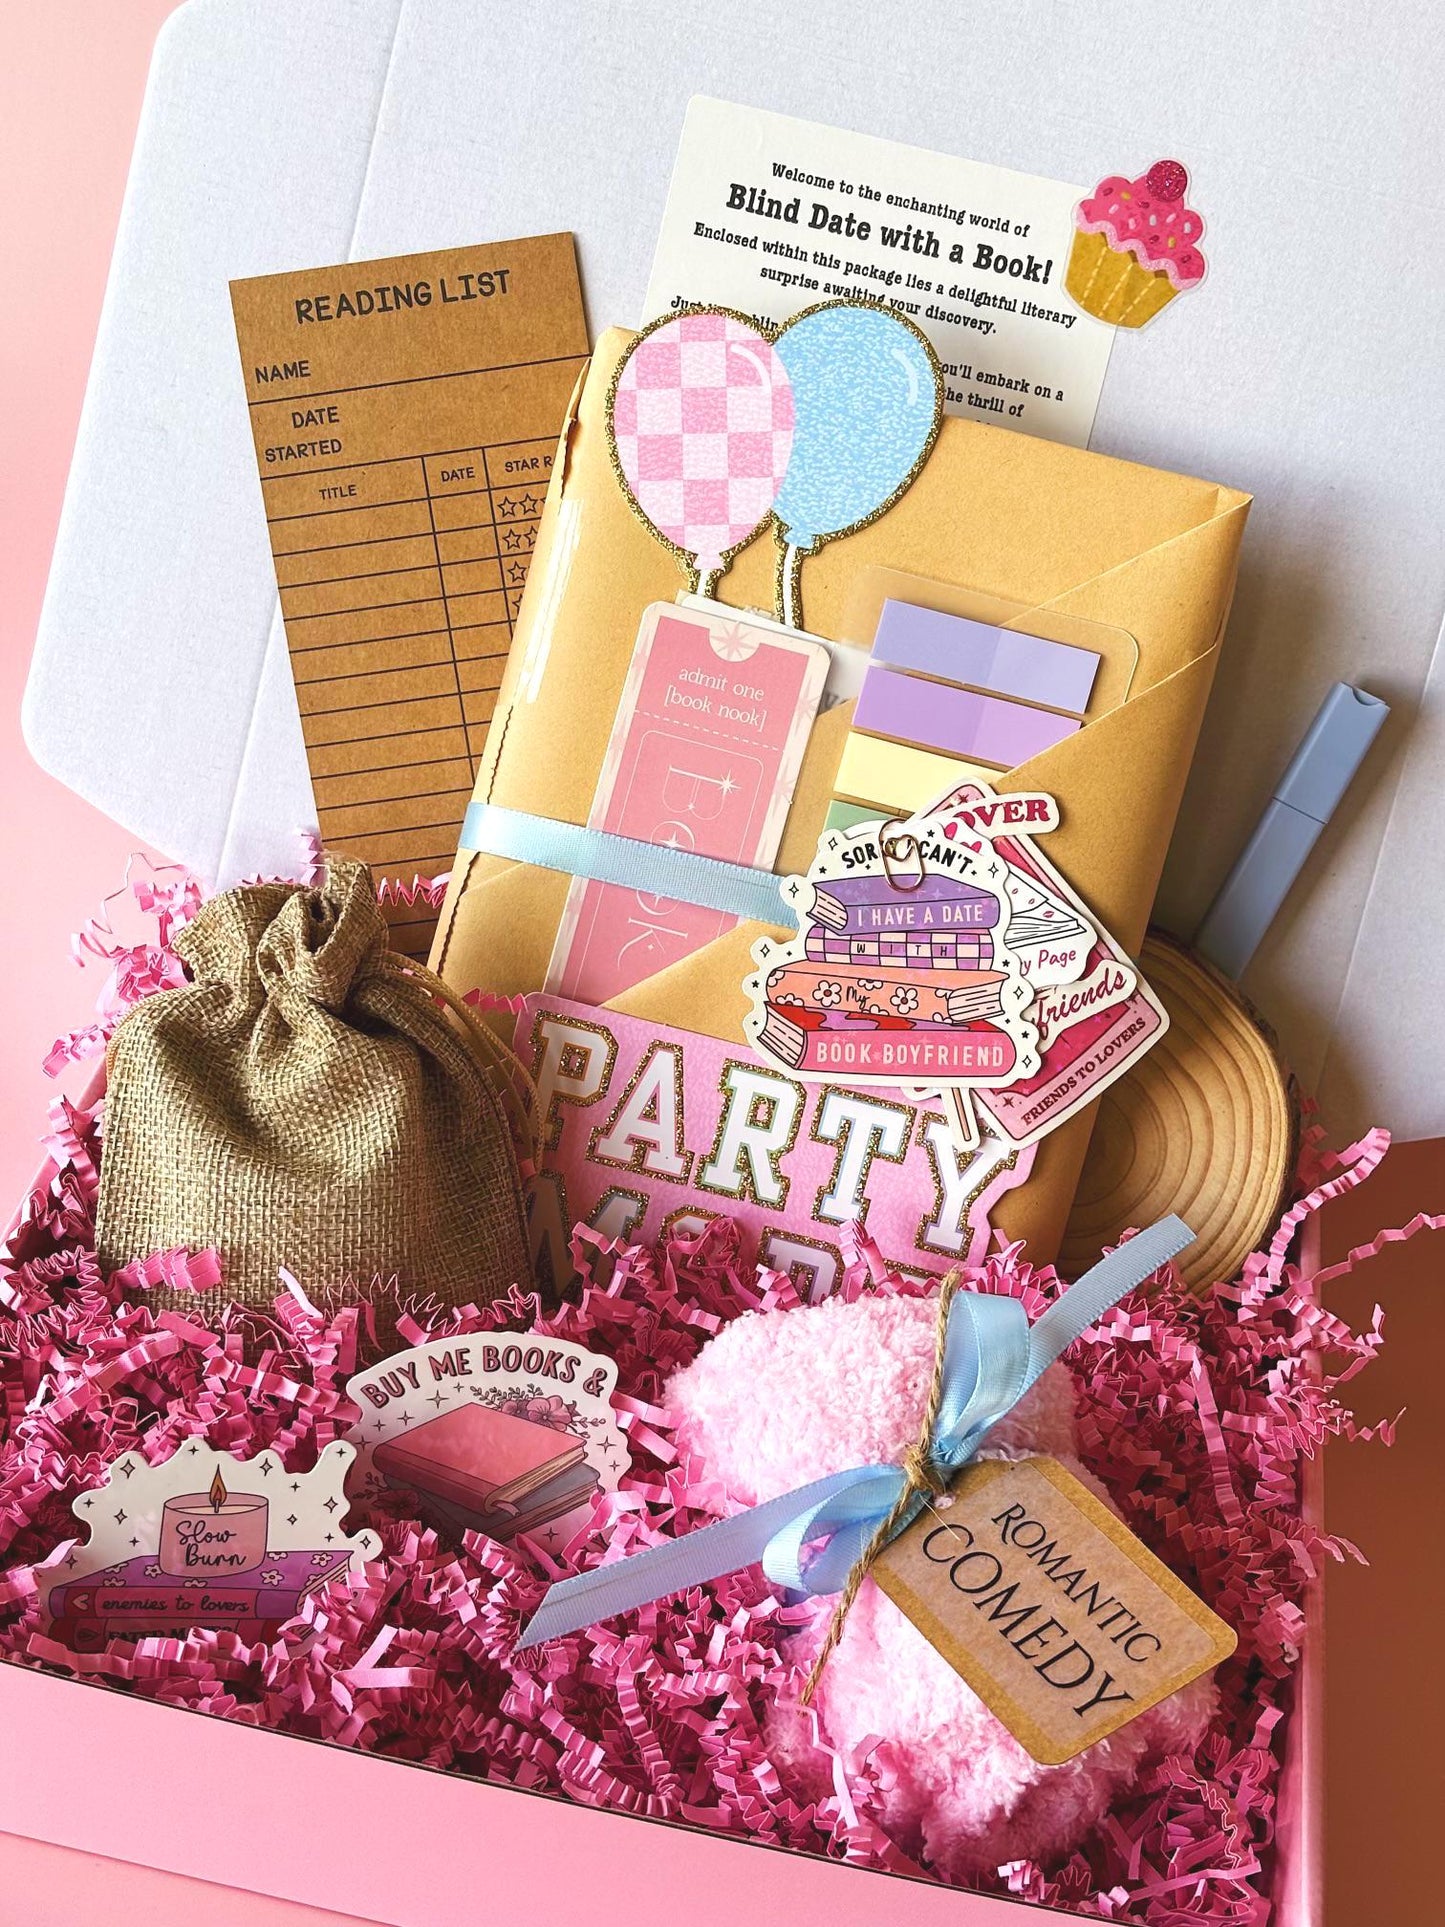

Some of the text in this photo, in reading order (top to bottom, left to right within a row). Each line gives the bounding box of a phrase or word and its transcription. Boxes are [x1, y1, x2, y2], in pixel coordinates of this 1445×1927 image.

[771, 162, 1031, 238] Welcome to the enchanting world of
[726, 183, 1053, 285] Blind Date with a Book!
[693, 221, 1078, 330] Enclosed within this package lies a delightful literary
[295, 269, 511, 324] READING LIST
[760, 266, 819, 288] surprise
[889, 297, 922, 316] your
[925, 305, 998, 337] discovery.
[254, 360, 312, 384] NAME
[975, 371, 1032, 393] embark
[1034, 384, 1052, 399] on
[1055, 389, 1065, 402] a
[291, 406, 340, 429] DATE
[967, 391, 1004, 414] thrill
[1008, 403, 1025, 418] of
[264, 438, 343, 463] STARTED
[440, 466, 476, 483] DATE
[504, 457, 540, 474] STAR
[318, 484, 358, 502] TITLE
[678, 667, 765, 701] admit one
[663, 684, 767, 733] [book nook]
[858, 904, 984, 927] I HAVE A DATE
[856, 943, 948, 955] WITH
[1038, 949, 1077, 969] Page
[846, 985, 871, 1010] My
[816, 1041, 1003, 1067] BOOK BOYFRIEND
[1020, 1016, 1146, 1126] FRIENDS TO LOVERS
[533, 1008, 1020, 1260] PARTY
[360, 1345, 608, 1409] BUY ME BOOKS &
[175, 1520, 237, 1545] Slow
[185, 1543, 247, 1566] Burn
[991, 1502, 1162, 1663] ROMANTIC
[102, 1594, 250, 1613] enemies to lovers
[921, 1523, 1135, 1718] COMEDY
